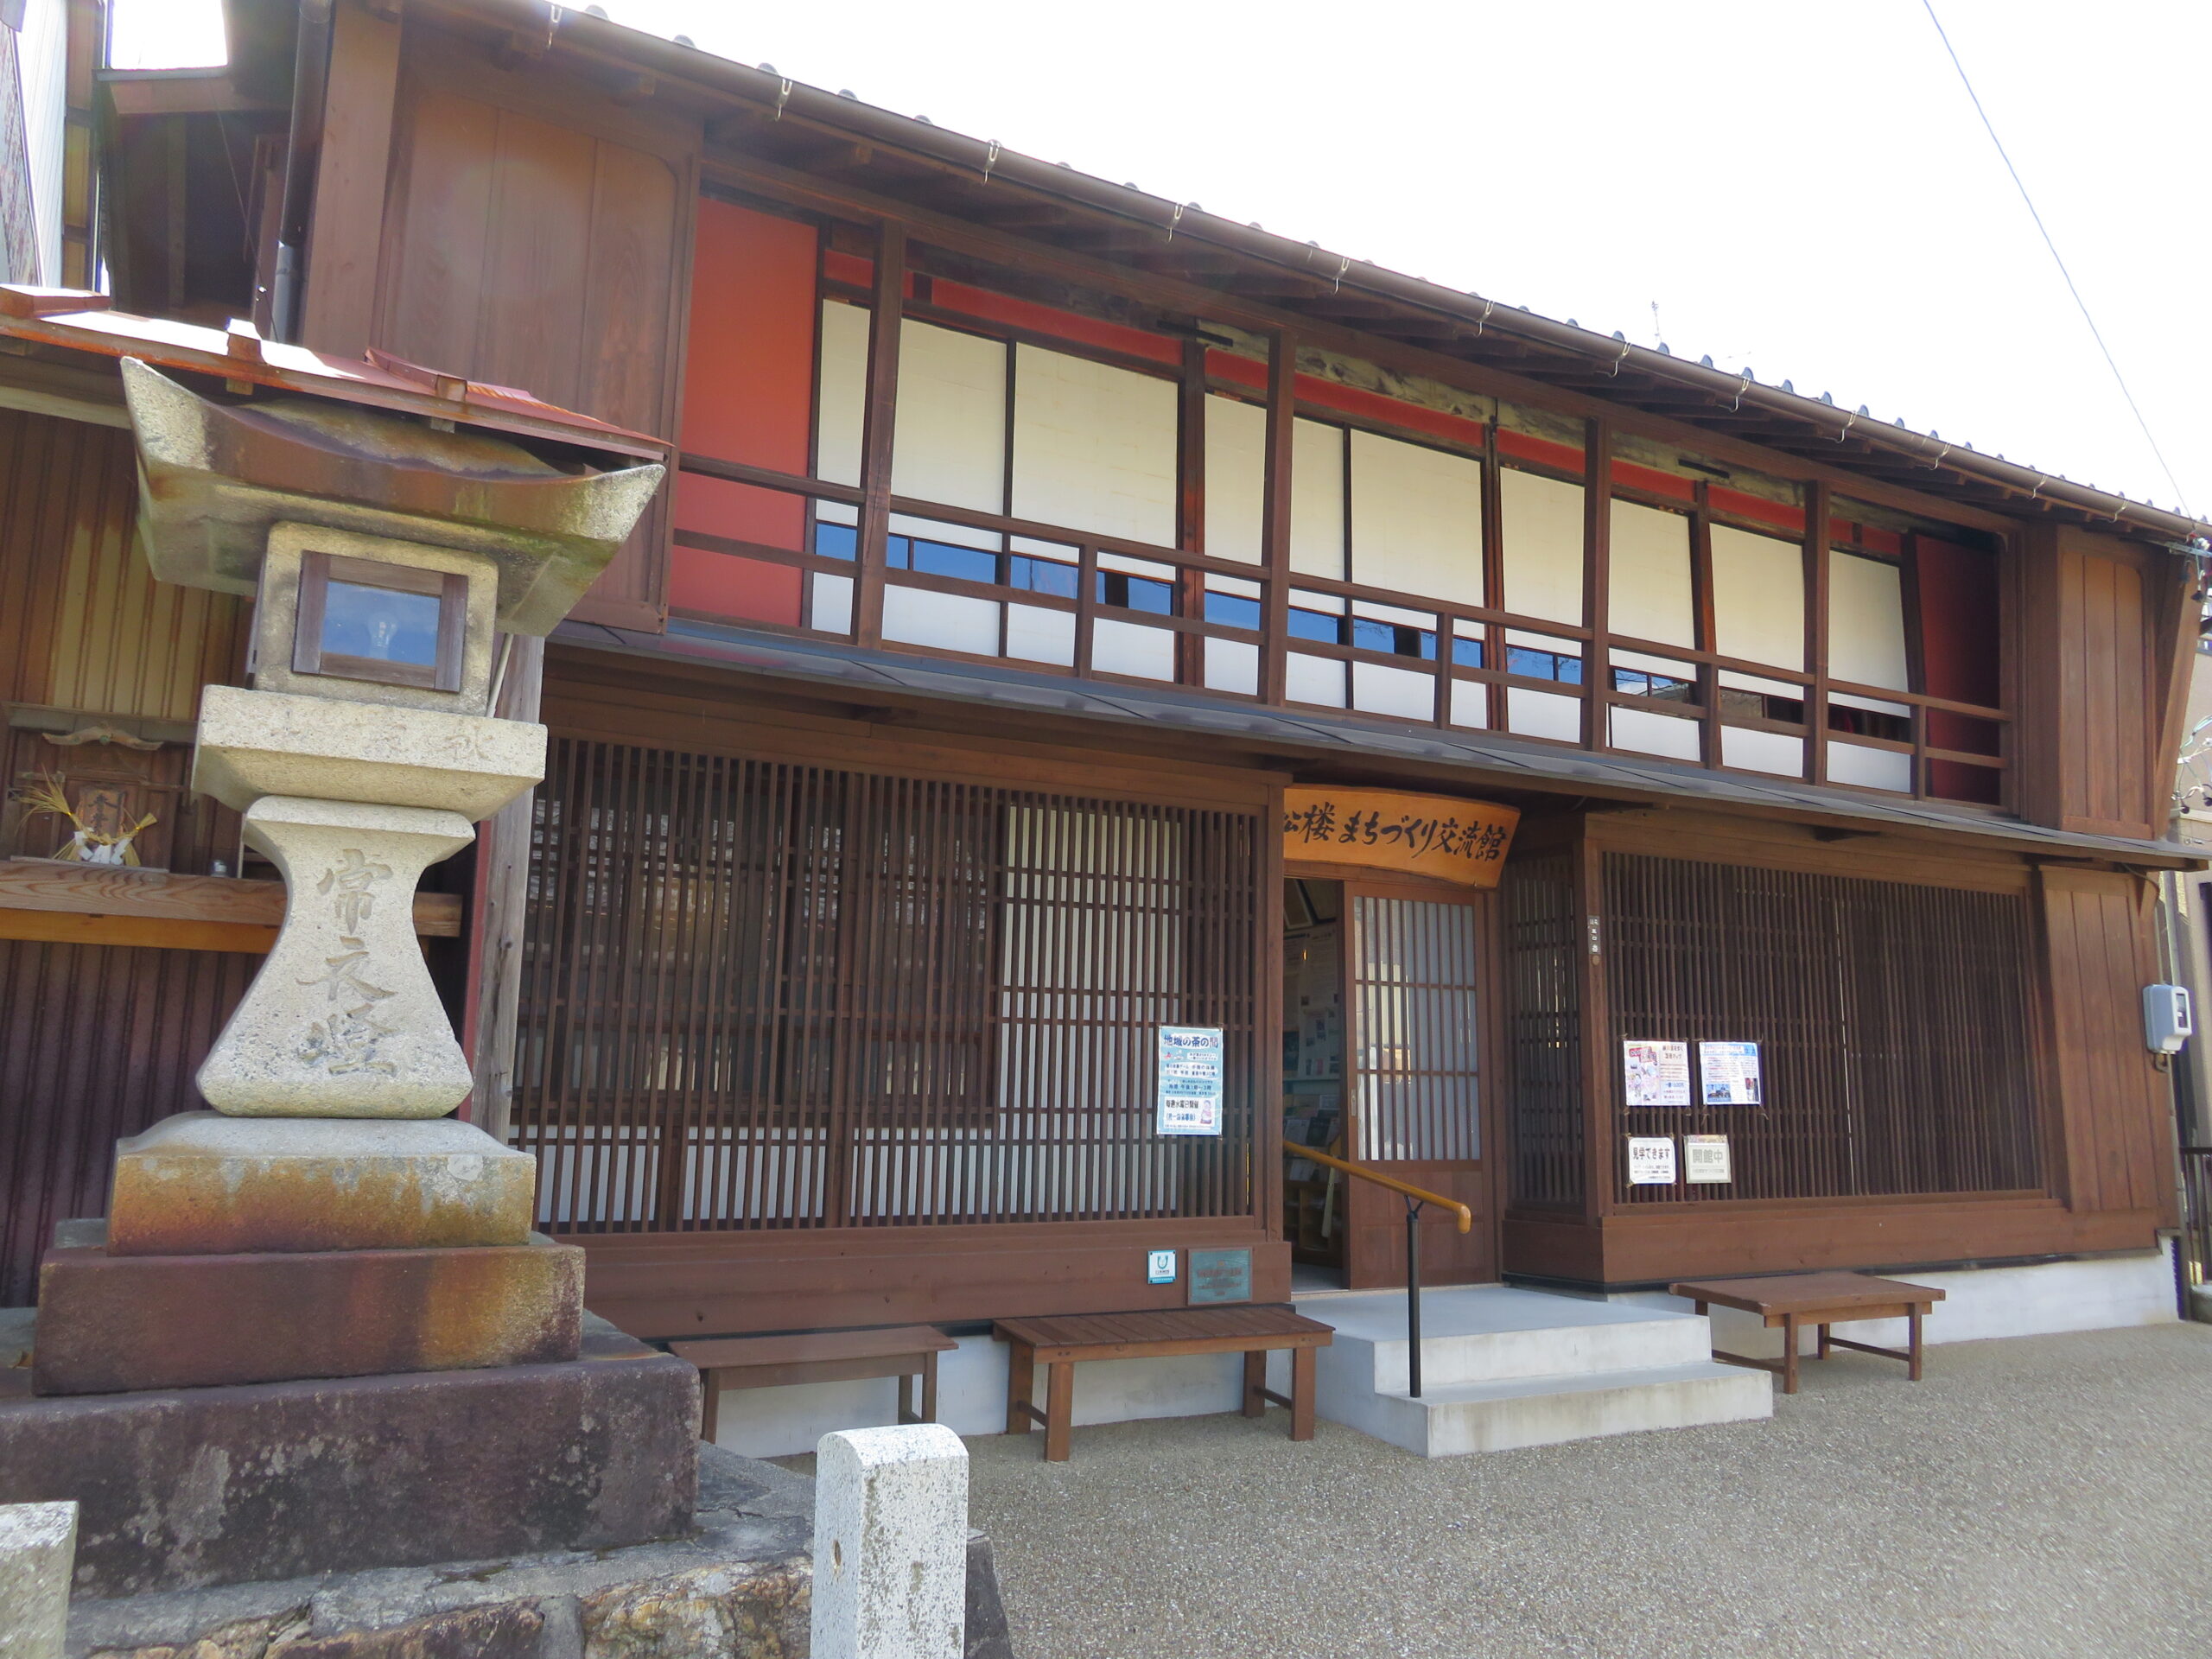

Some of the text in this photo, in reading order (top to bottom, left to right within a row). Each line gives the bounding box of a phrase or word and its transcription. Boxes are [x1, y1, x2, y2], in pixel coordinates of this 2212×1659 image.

[1164, 1033, 1218, 1048] 地域の茶の間
[1632, 1147, 1670, 1160] 見学できます
[1692, 1148, 1724, 1164] 開館中
